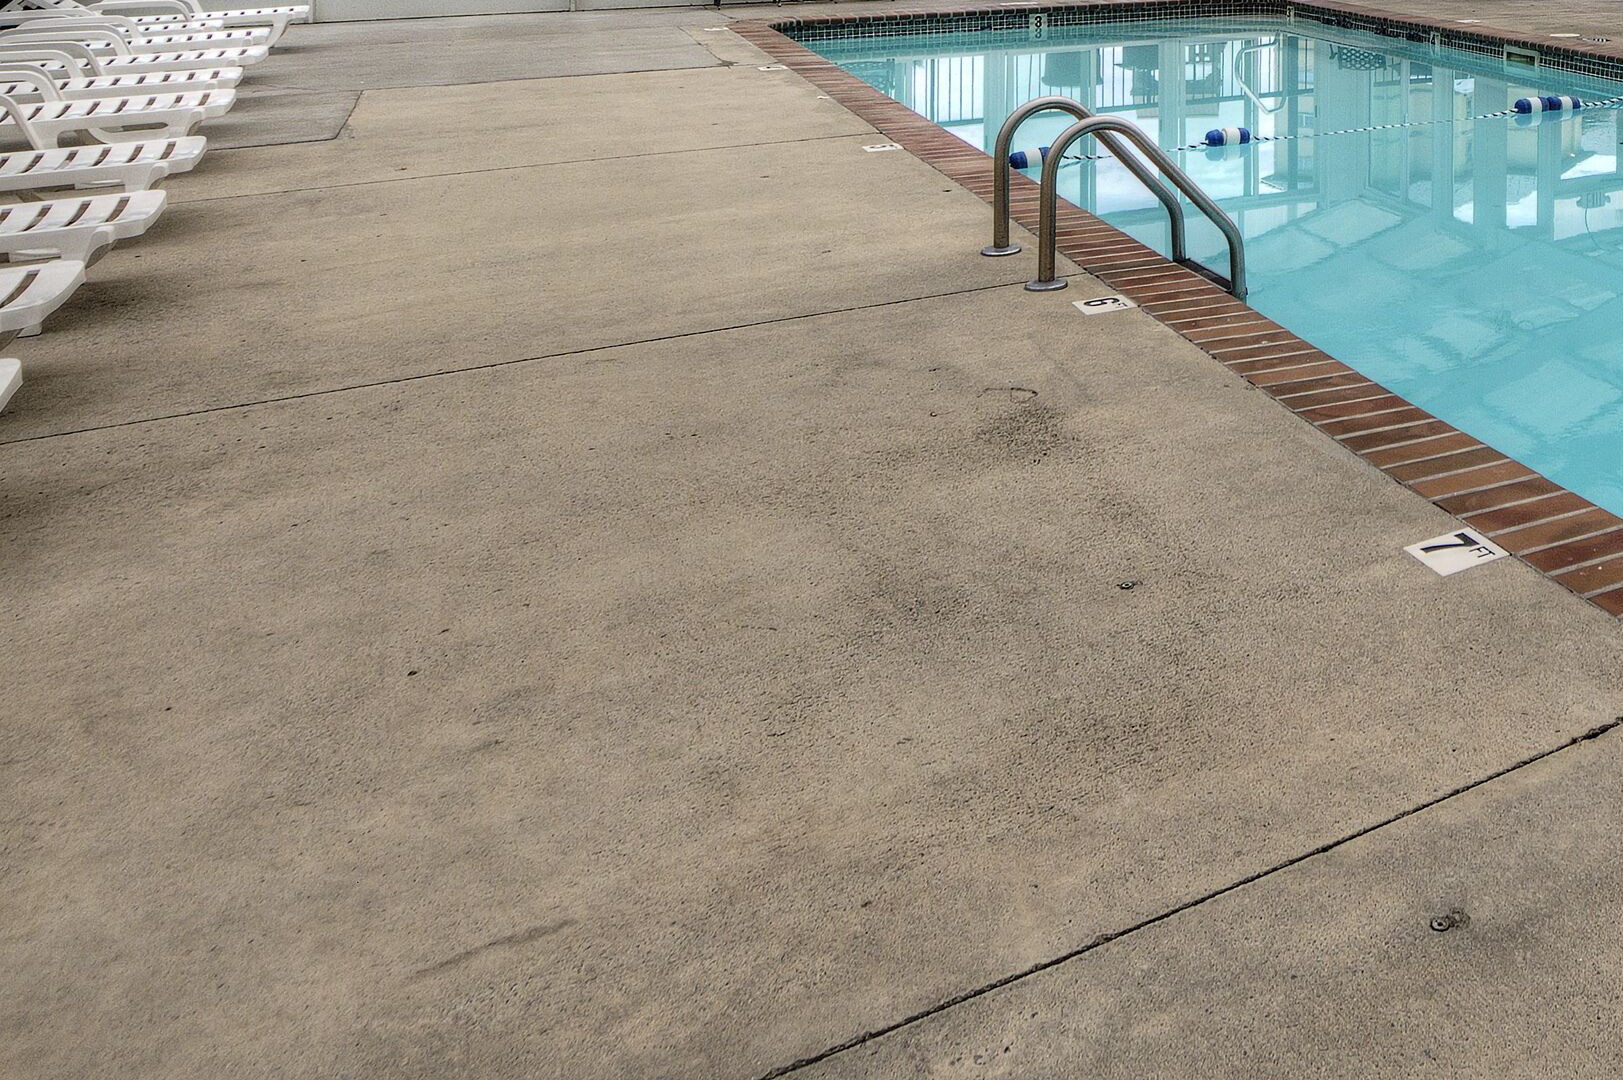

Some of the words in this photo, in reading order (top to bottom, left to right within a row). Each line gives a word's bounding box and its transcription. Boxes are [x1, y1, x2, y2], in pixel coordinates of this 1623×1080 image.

[1083, 297, 1119, 306] 6
[1420, 532, 1480, 553] 7
[1469, 546, 1496, 558] FT
